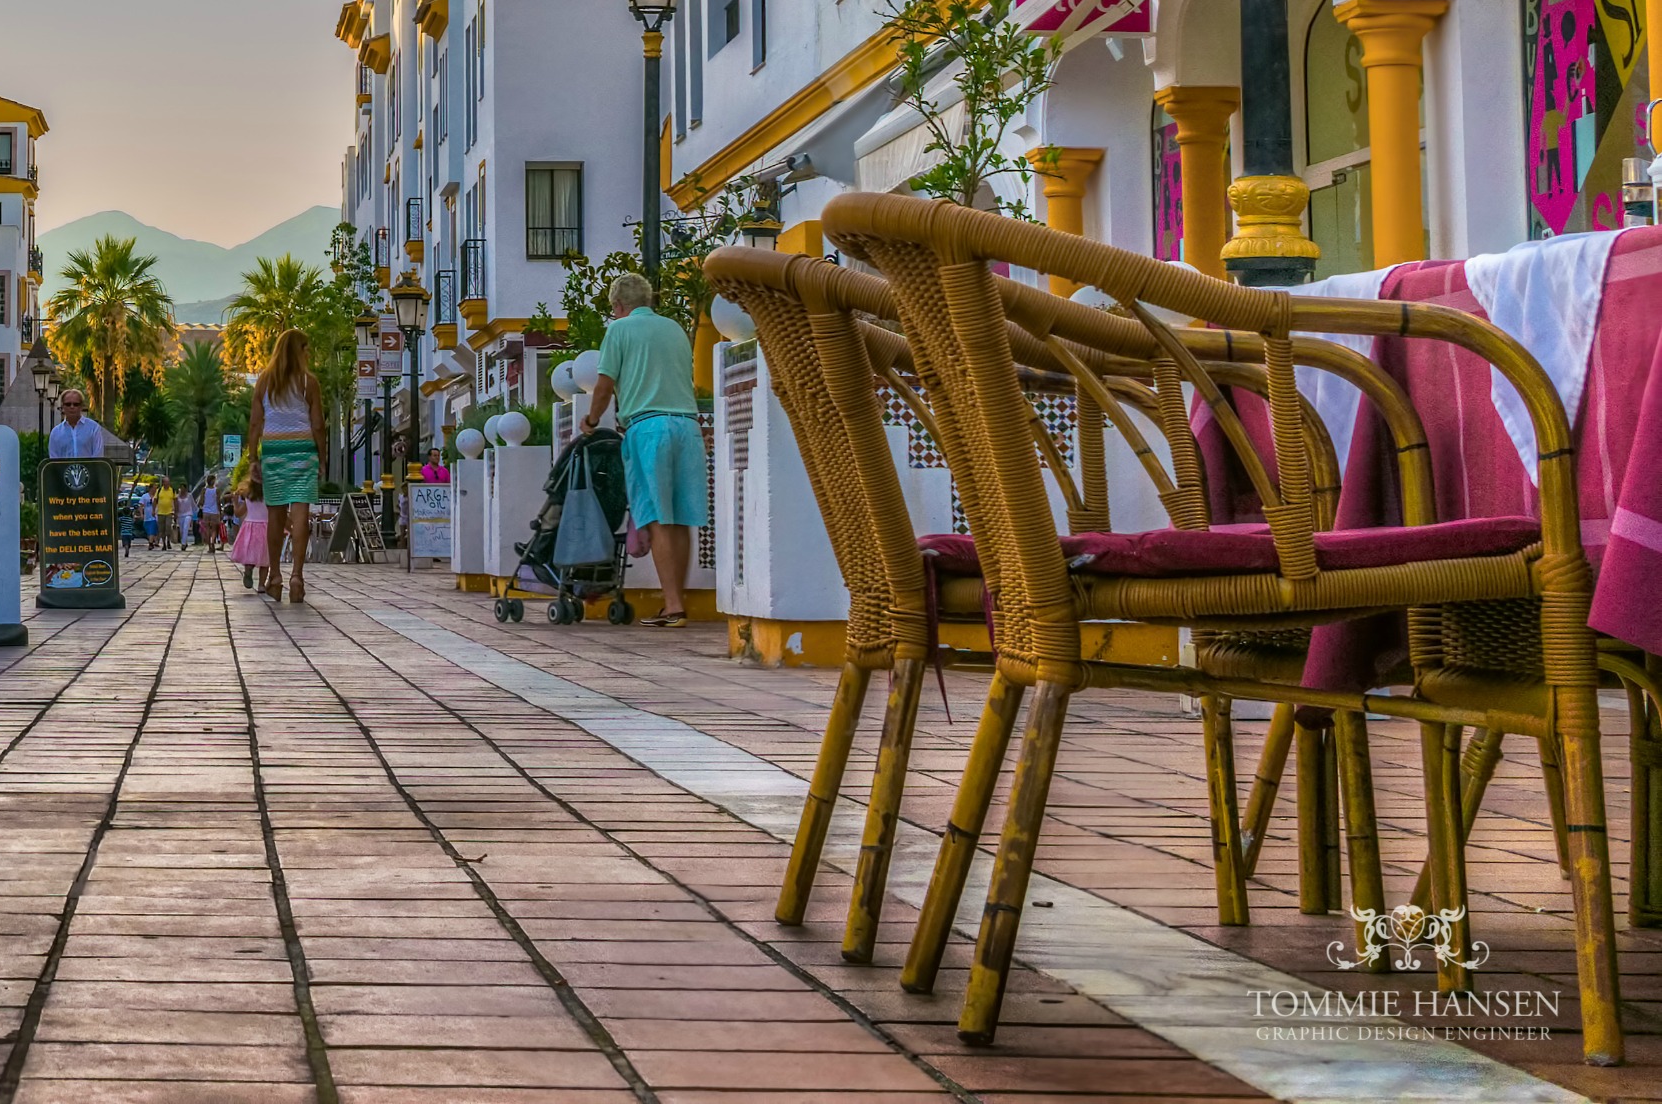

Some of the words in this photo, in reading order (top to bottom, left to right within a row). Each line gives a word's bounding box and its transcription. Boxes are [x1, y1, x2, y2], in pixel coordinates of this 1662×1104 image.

[415, 488, 451, 504] ARGA
[49, 497, 65, 506] Why
[67, 497, 77, 506] try
[78, 496, 91, 504] the
[92, 496, 107, 504] rest
[429, 501, 446, 510] OIL
[53, 513, 74, 521] when
[74, 513, 89, 522] you
[89, 513, 104, 521] can
[49, 529, 67, 537] have
[68, 529, 81, 537] the
[82, 528, 99, 536] best
[100, 528, 109, 536] at
[45, 546, 58, 554] the
[59, 545, 77, 553] DELI
[78, 545, 94, 553] DEL
[95, 544, 113, 553] MAR
